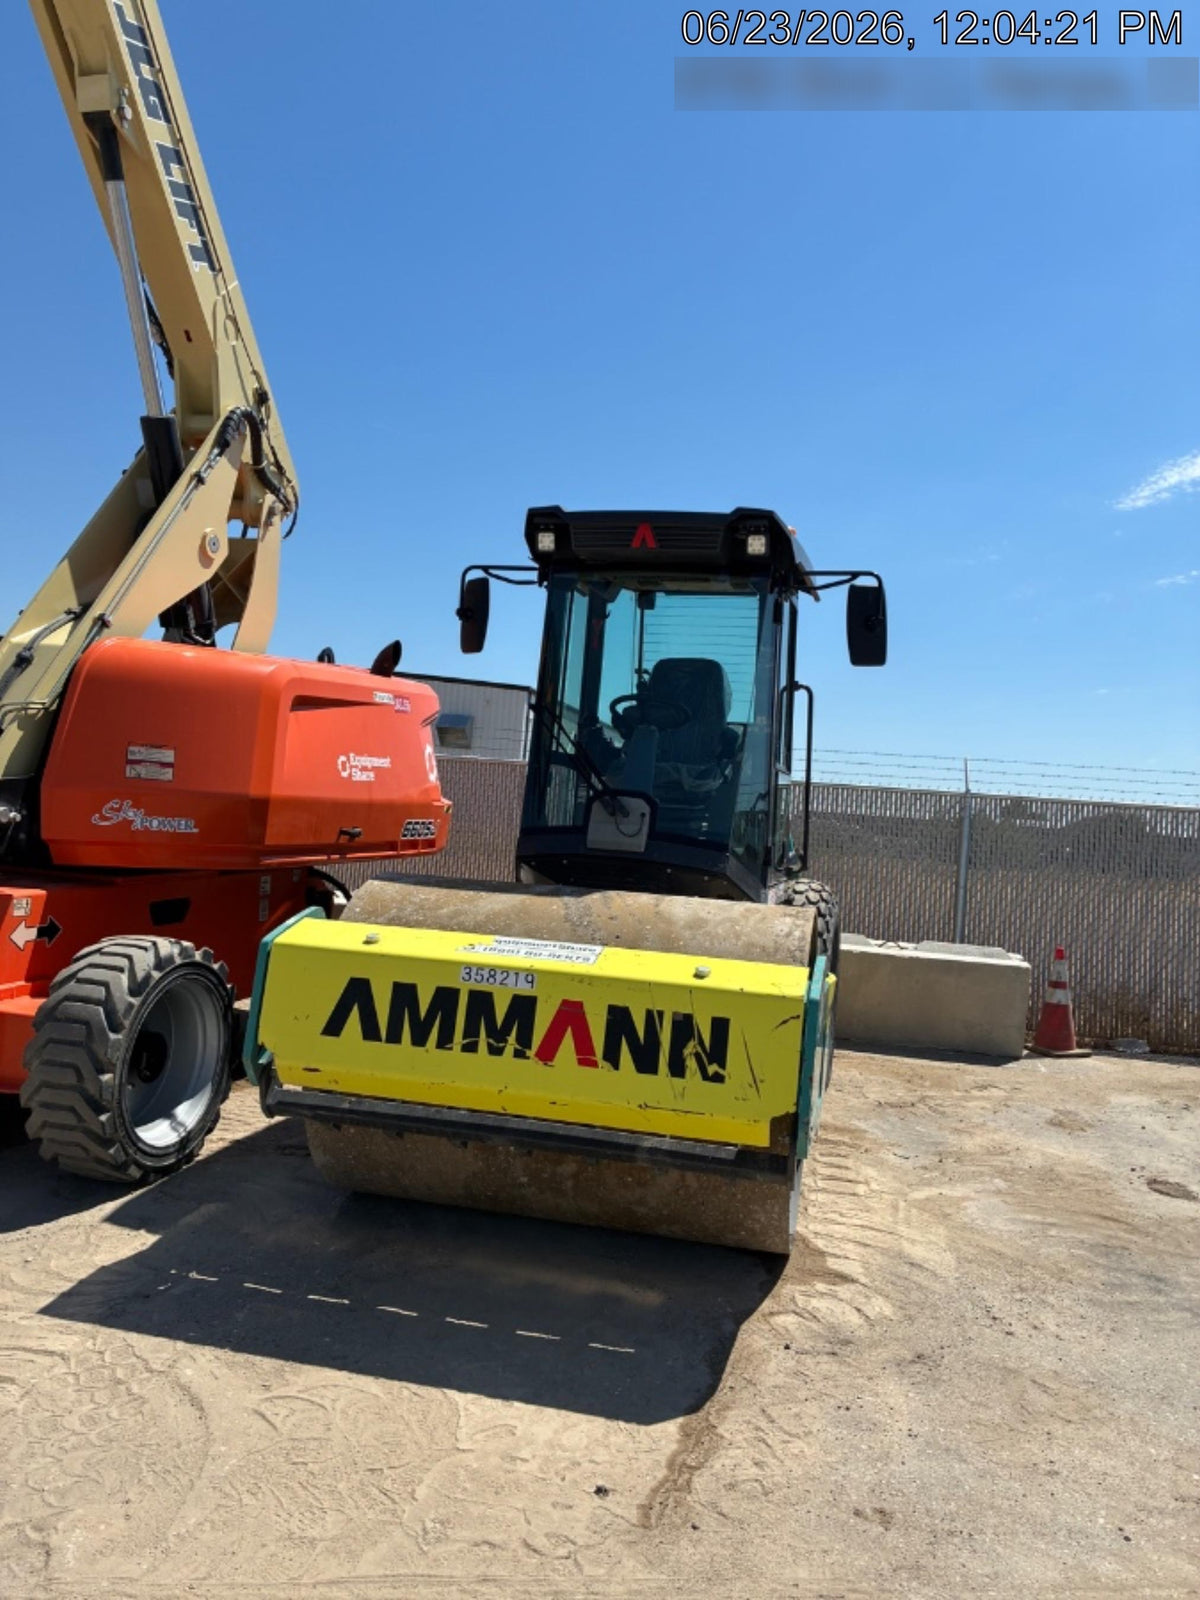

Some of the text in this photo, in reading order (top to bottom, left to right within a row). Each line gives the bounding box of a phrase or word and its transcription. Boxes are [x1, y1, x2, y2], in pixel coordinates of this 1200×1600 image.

[113, 1, 219, 274] JLG LIFT
[320, 976, 731, 1084] AMMANN
[461, 966, 536, 989] 358219
